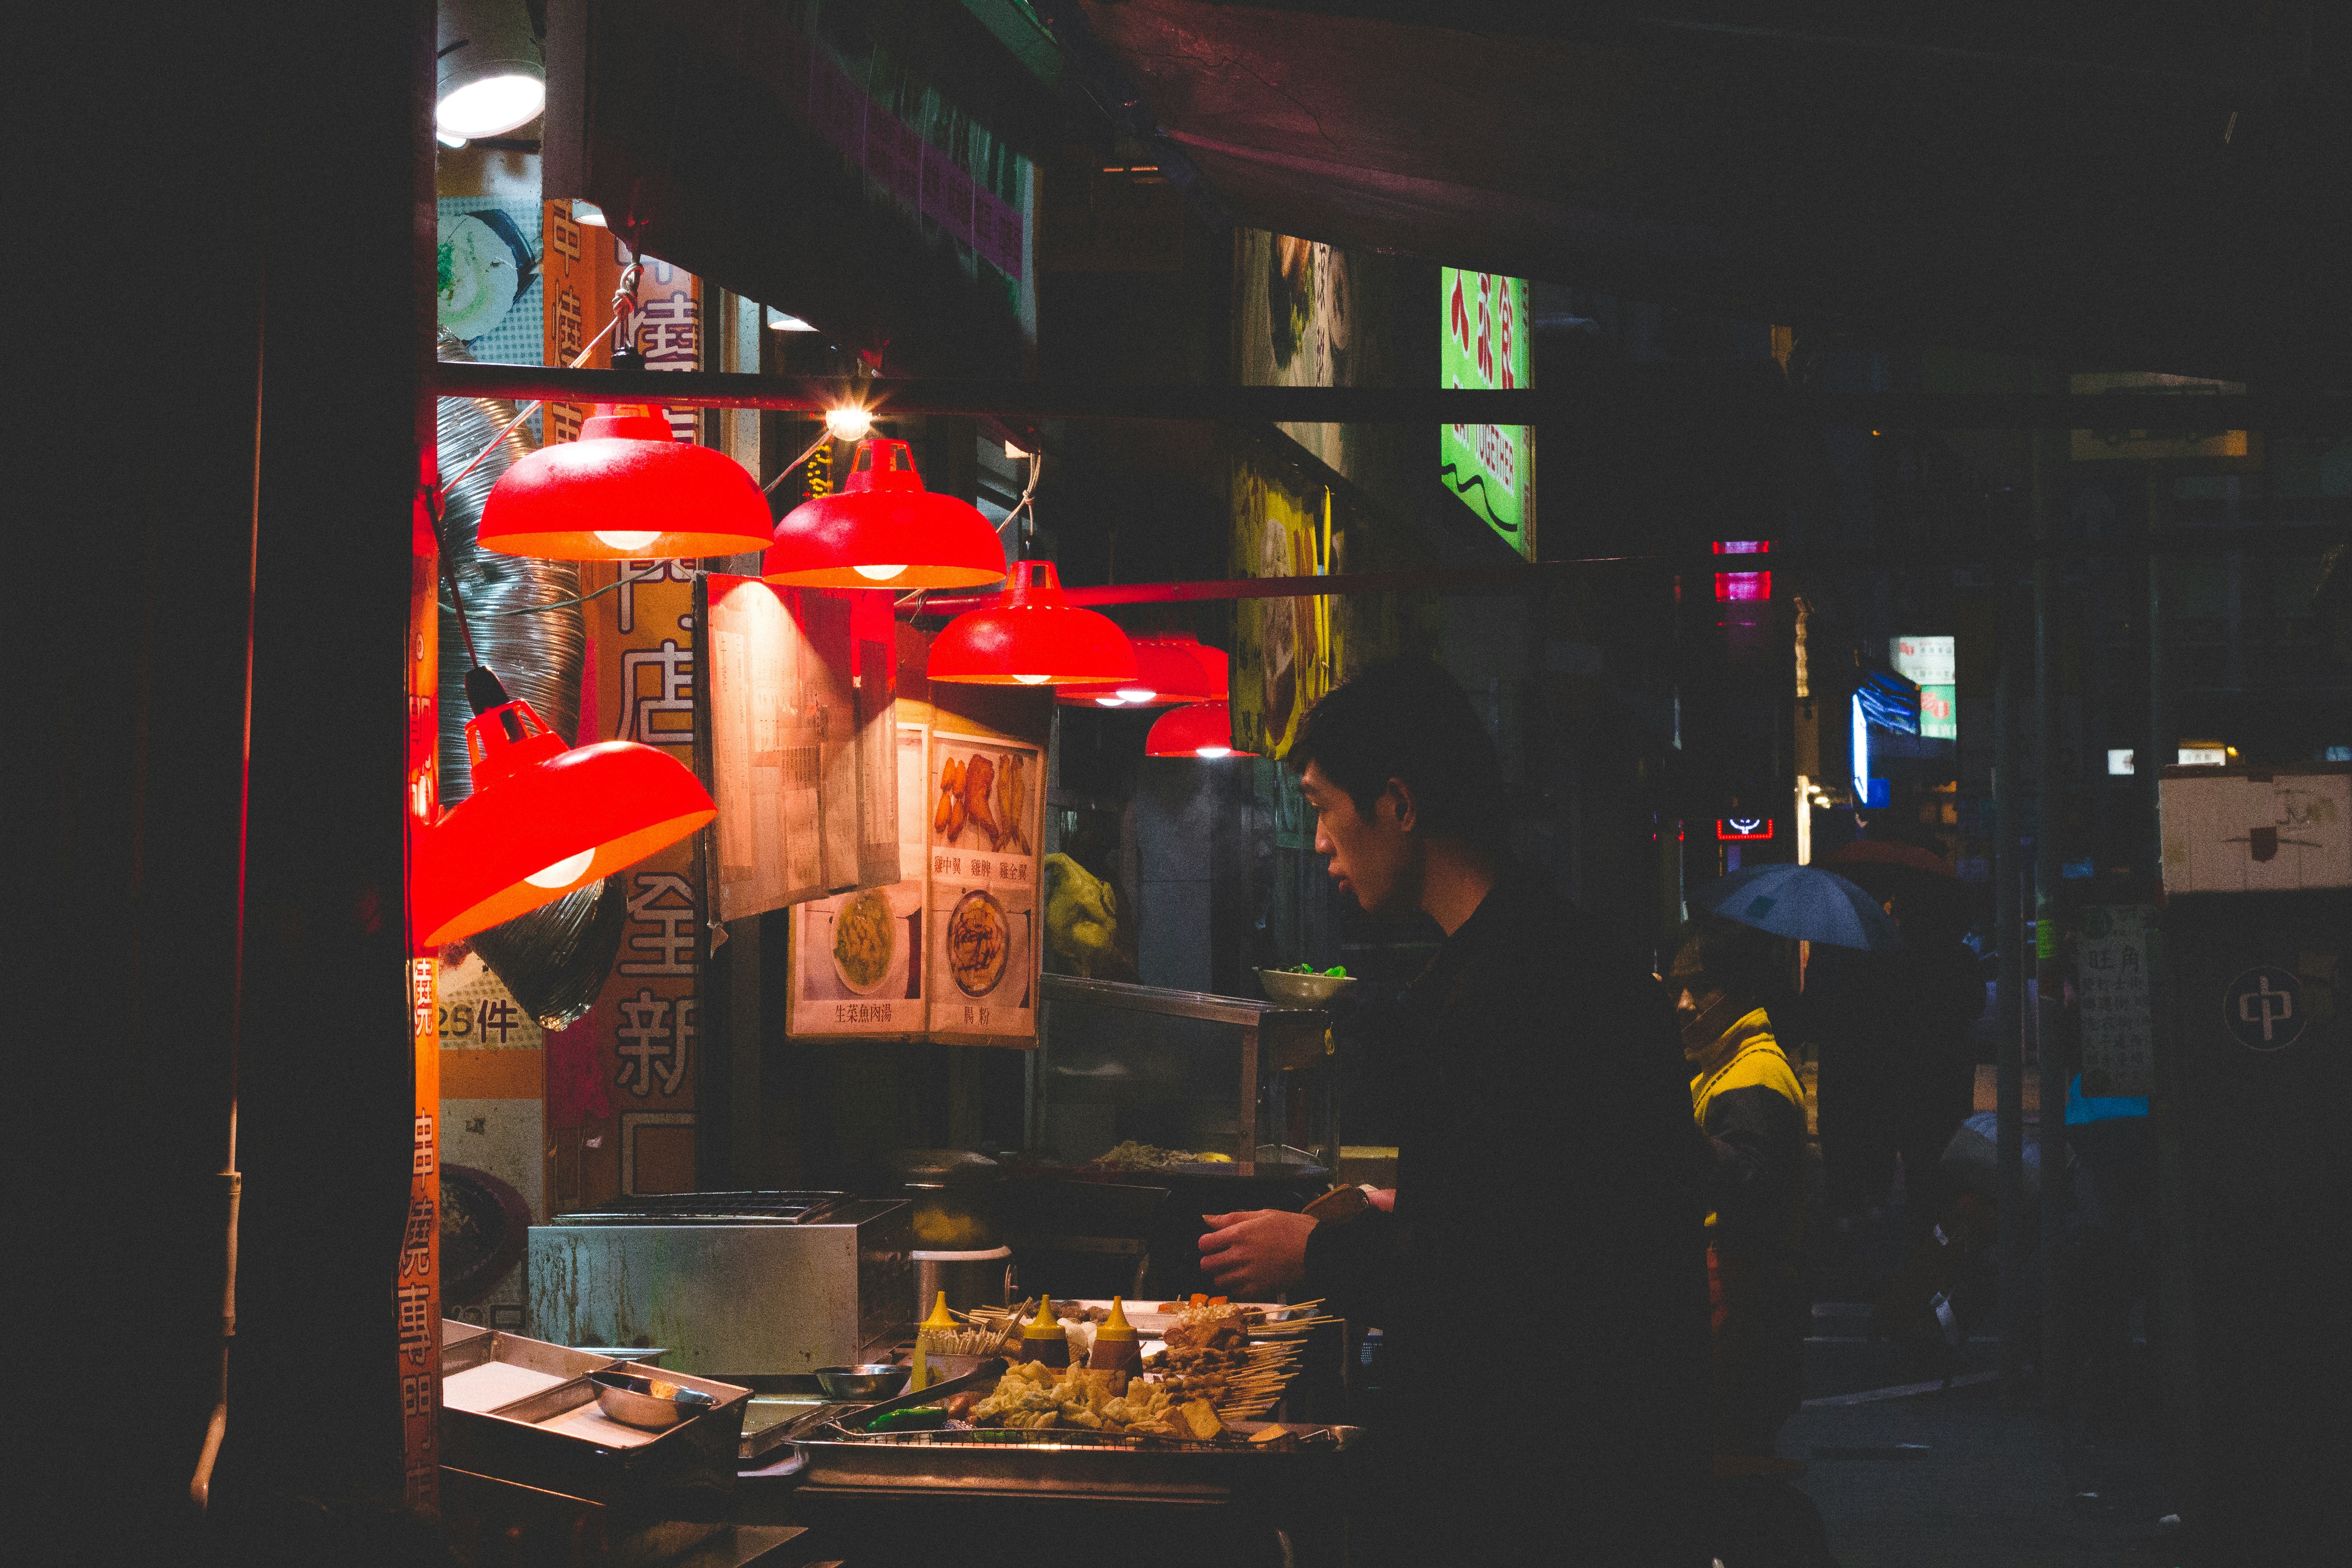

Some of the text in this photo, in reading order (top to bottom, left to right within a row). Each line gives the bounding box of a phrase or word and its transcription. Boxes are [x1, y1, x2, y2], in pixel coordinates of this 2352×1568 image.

[934, 855, 960, 875] 雞中翼
[971, 858, 990, 877] 雞脾
[834, 1003, 892, 1024] 生菜魚肉湯
